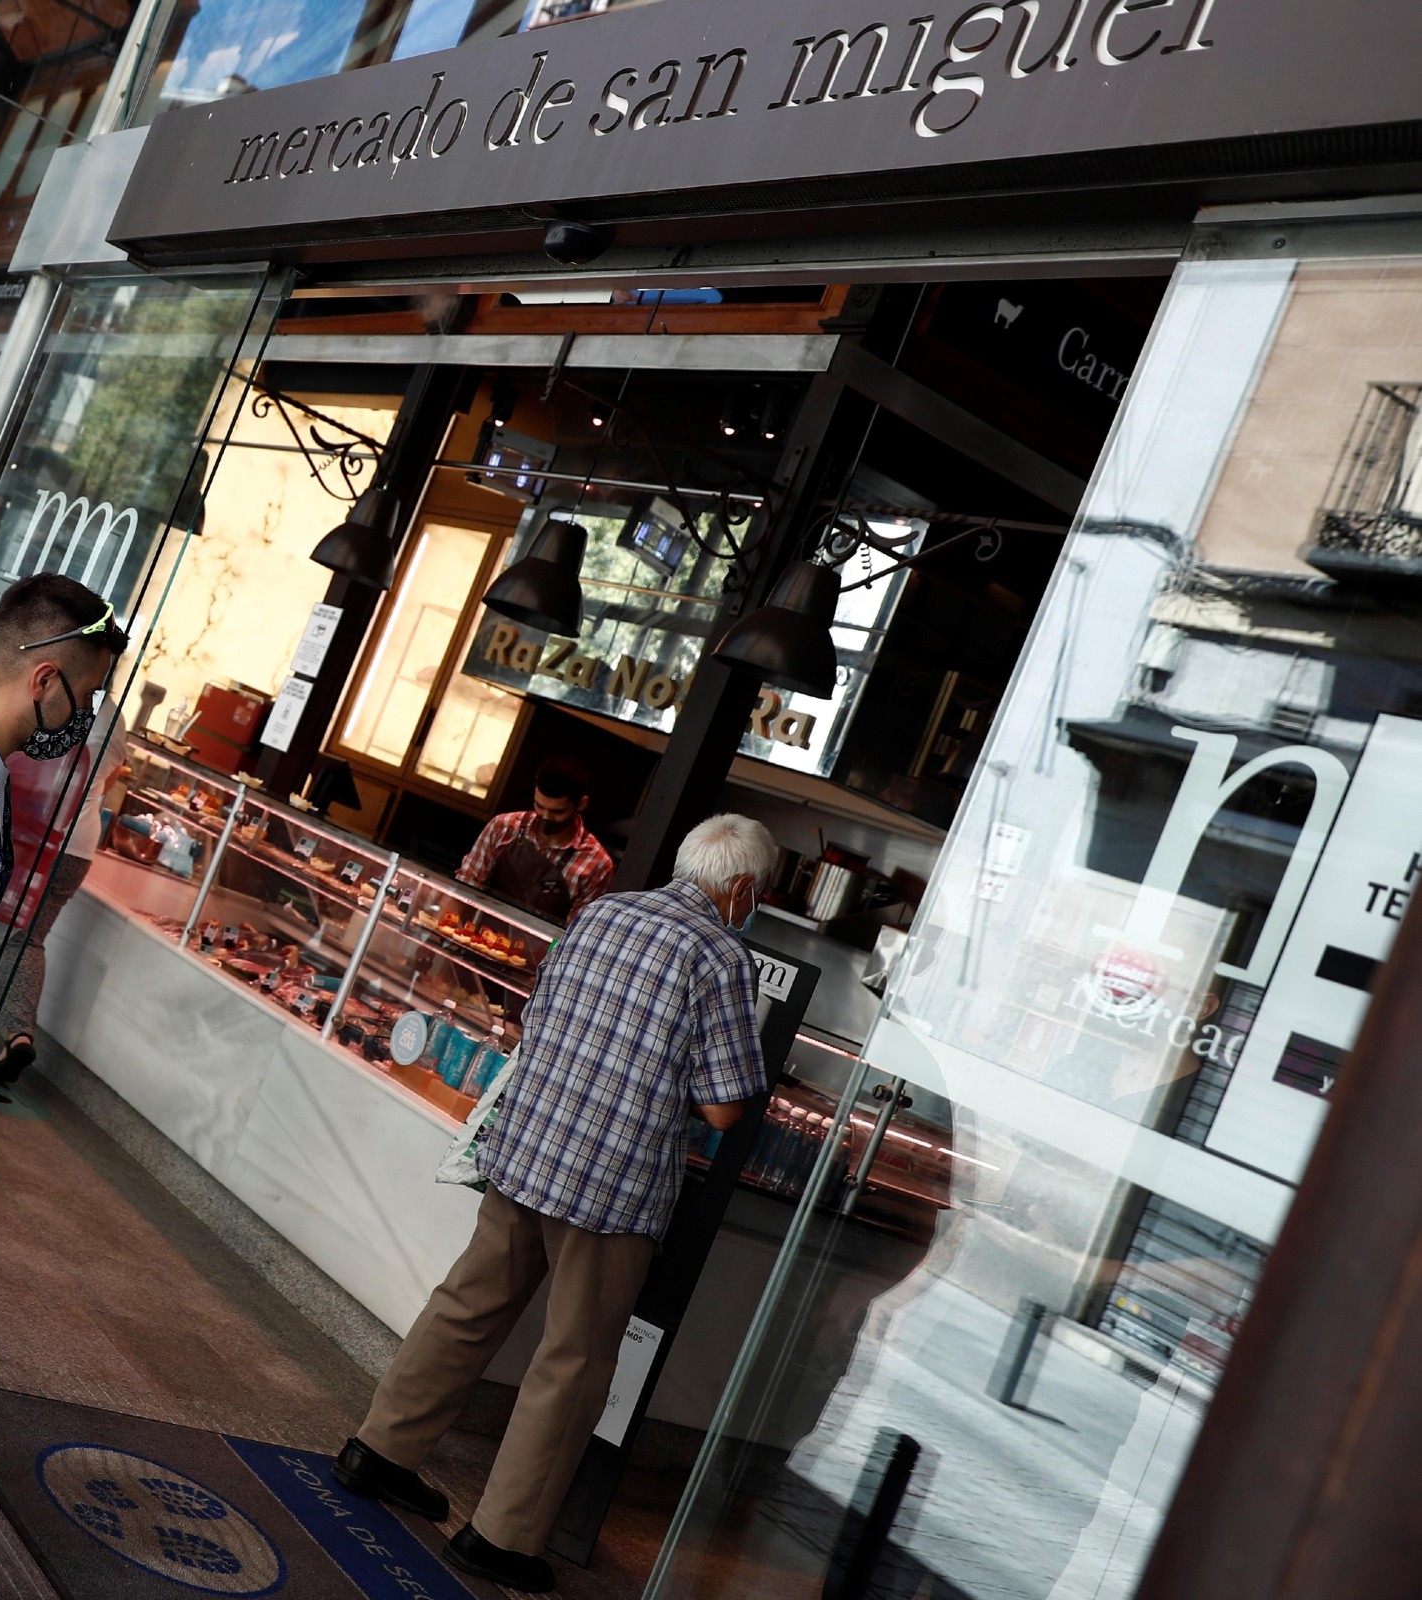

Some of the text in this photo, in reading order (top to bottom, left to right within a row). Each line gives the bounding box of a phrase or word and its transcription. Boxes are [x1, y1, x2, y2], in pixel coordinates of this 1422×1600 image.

[223, 71, 469, 185] mercado
[483, 50, 576, 152] de
[588, 47, 749, 138] san
[278, 1455, 353, 1517] ZONA
[346, 1526, 394, 1558] DE
